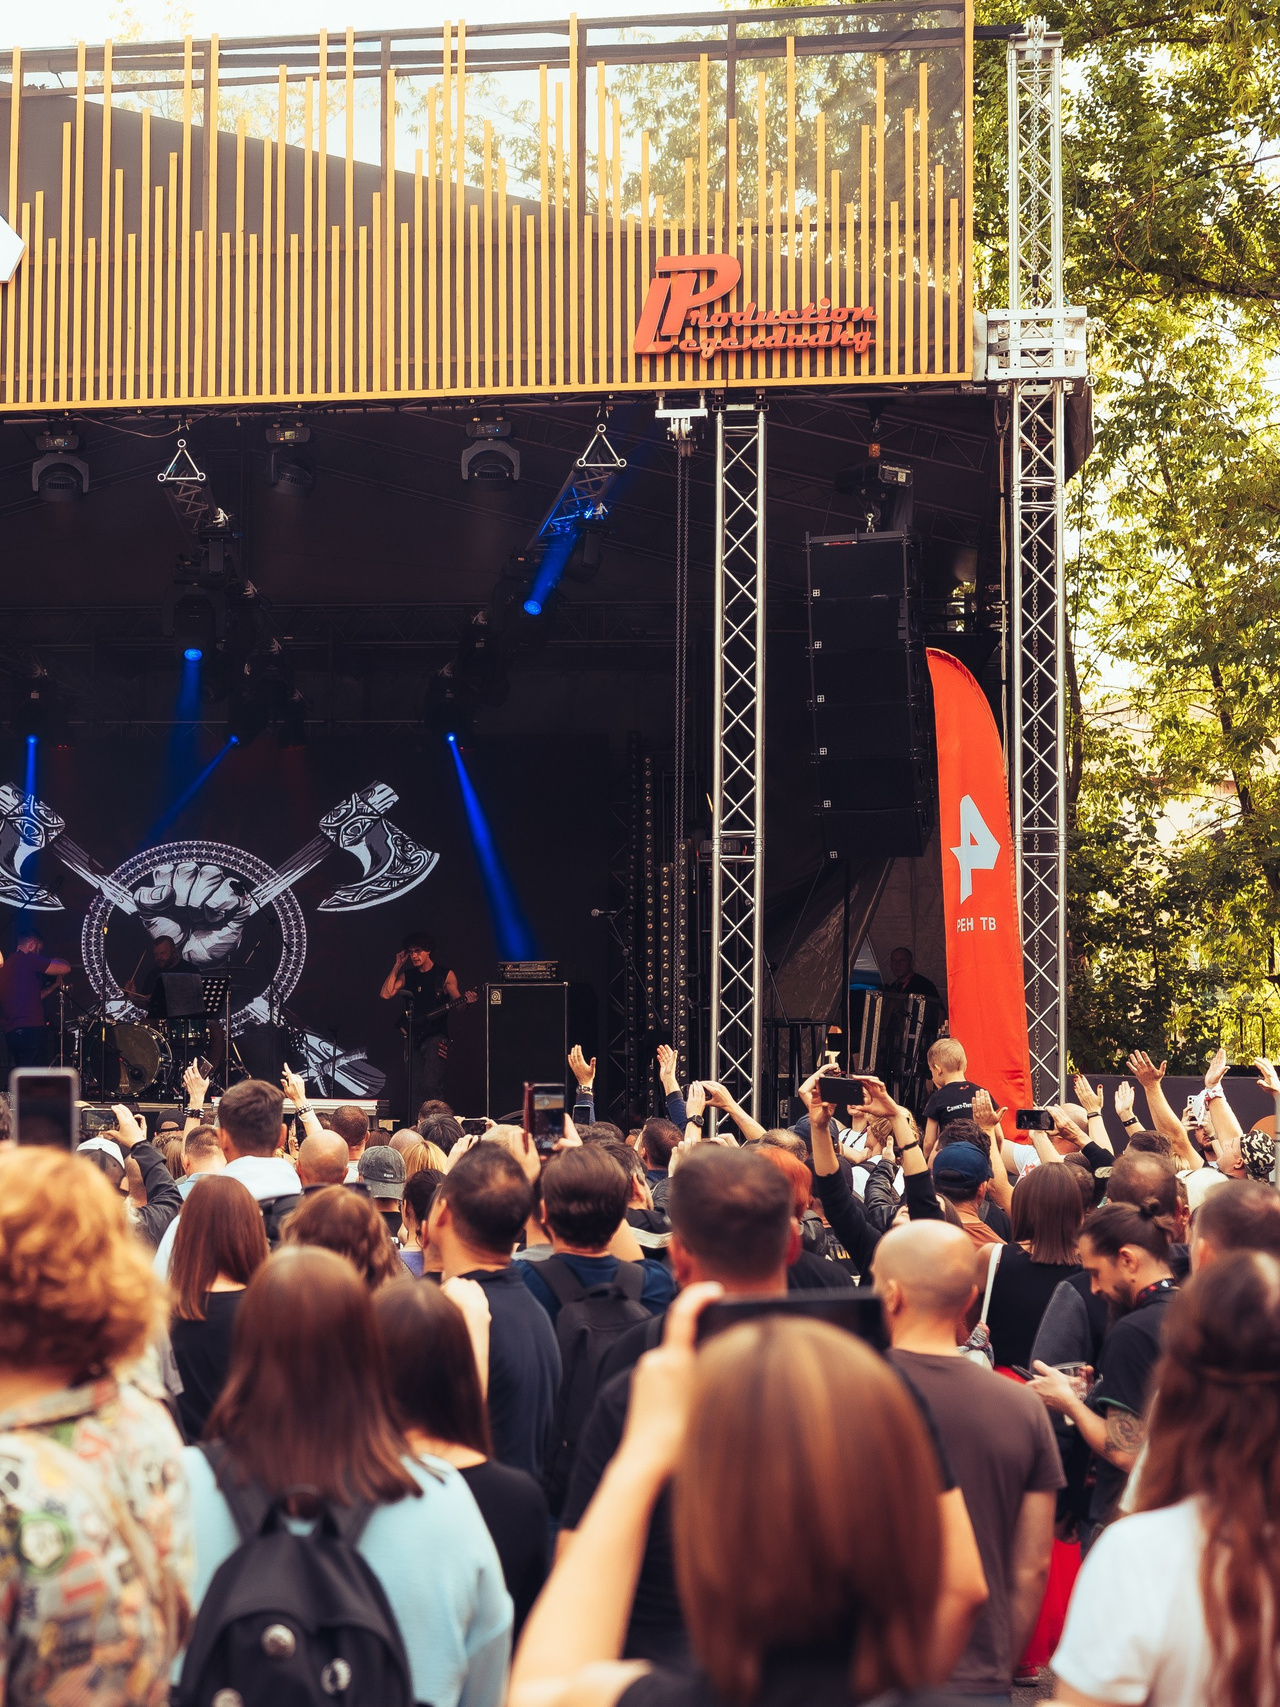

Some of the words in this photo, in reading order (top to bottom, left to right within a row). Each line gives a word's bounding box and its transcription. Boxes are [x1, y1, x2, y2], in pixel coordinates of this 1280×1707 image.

[655, 253, 877, 336] Production
[956, 917, 974, 933] РЕН
[979, 916, 997, 931] ТВ
